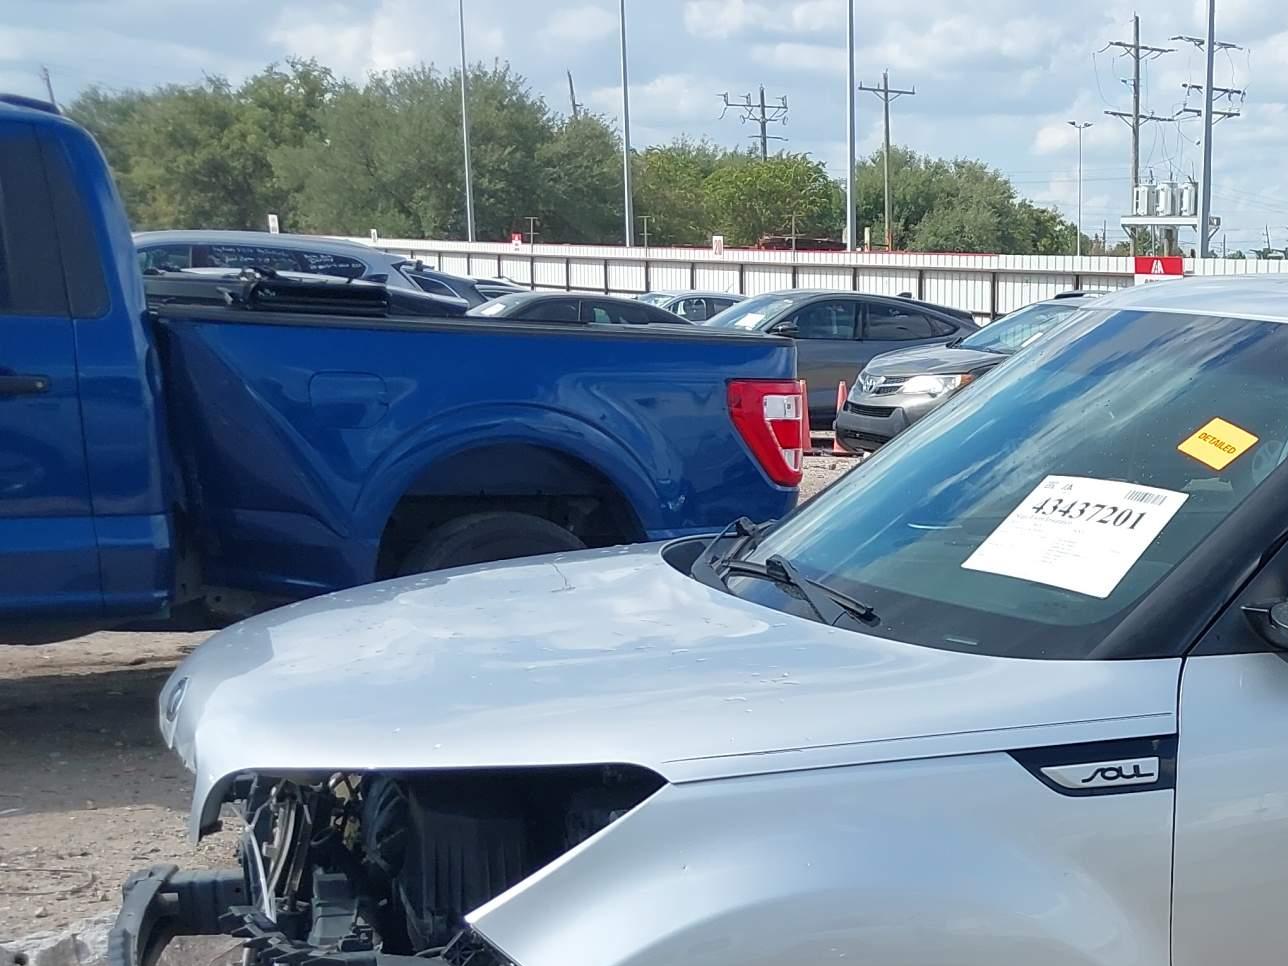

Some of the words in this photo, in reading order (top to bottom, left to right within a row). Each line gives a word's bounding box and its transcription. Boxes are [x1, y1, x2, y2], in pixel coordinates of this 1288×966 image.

[1197, 431, 1237, 455] DETAILED
[1031, 496, 1148, 530] 43437201
[1081, 764, 1155, 783] SOUL
